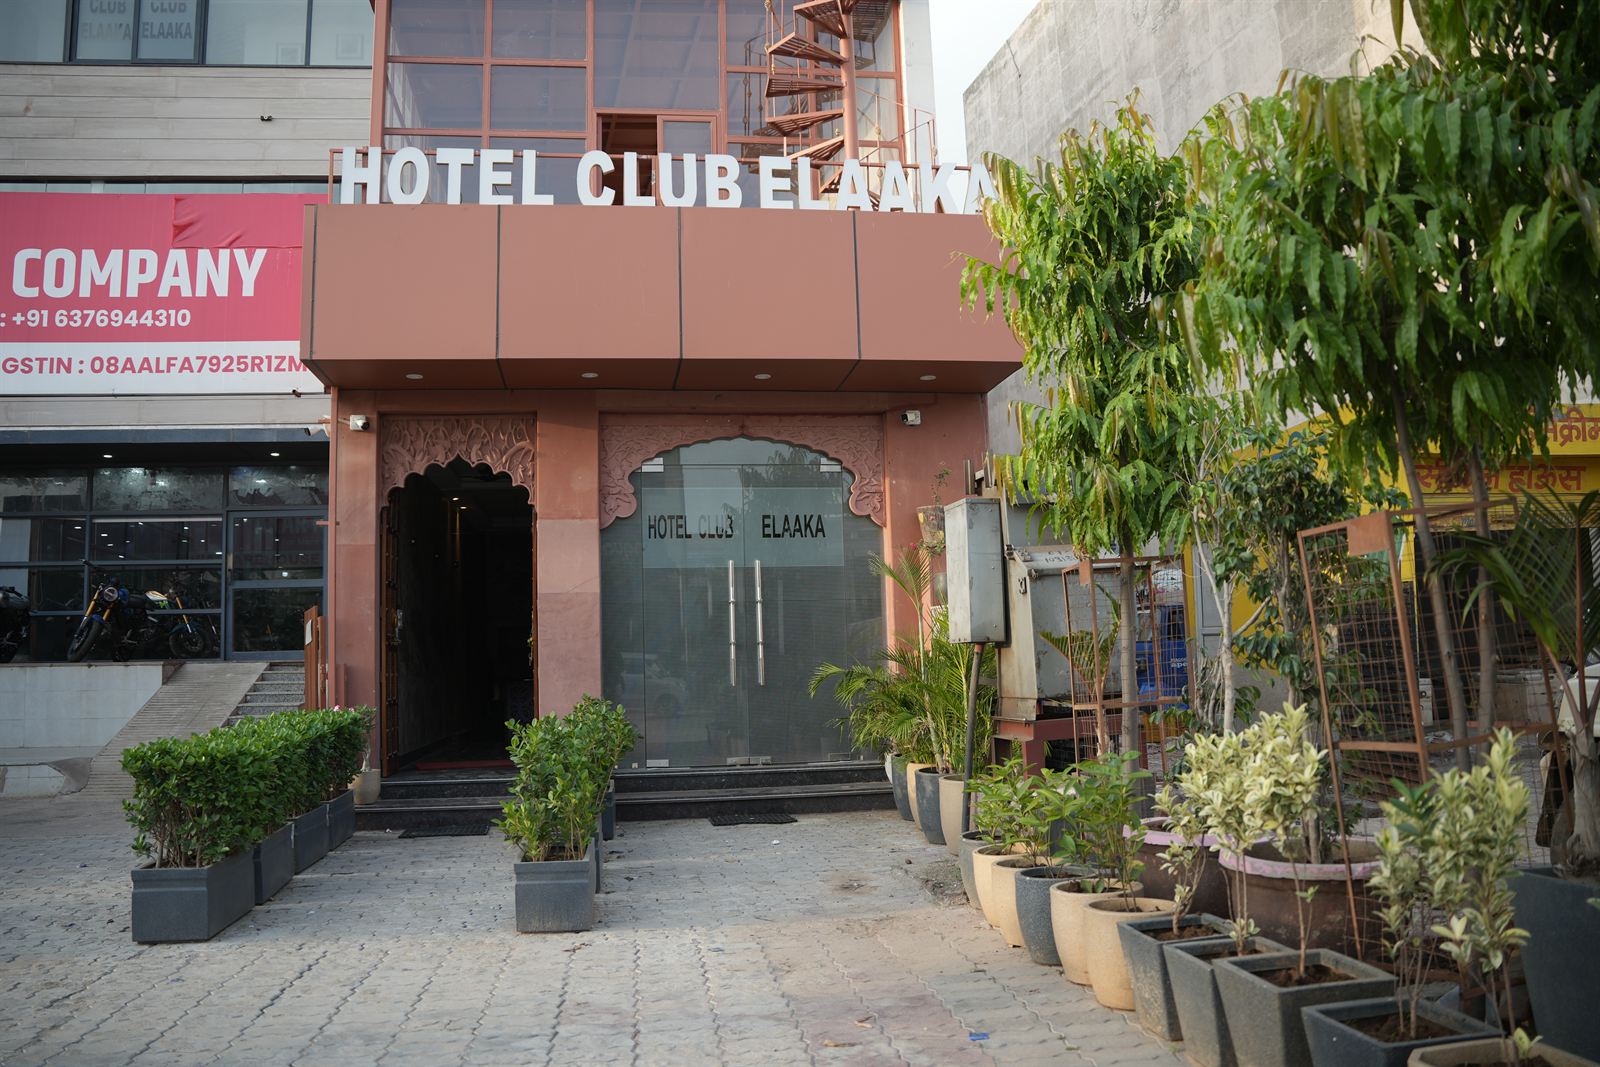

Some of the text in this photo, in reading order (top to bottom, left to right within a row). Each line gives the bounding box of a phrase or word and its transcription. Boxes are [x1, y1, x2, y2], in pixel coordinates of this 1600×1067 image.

[151, 0, 187, 13] CLUB
[142, 22, 192, 39] ELAAKA
[340, 146, 999, 214] HOTEL CLUB ELAAKA
[12, 248, 267, 298] COMPANY
[12, 309, 49, 328] +91
[54, 309, 192, 328] 6376944310
[1, 356, 72, 374] GSTIN
[648, 514, 826, 539] HOTEL CLUB ELAAKA
